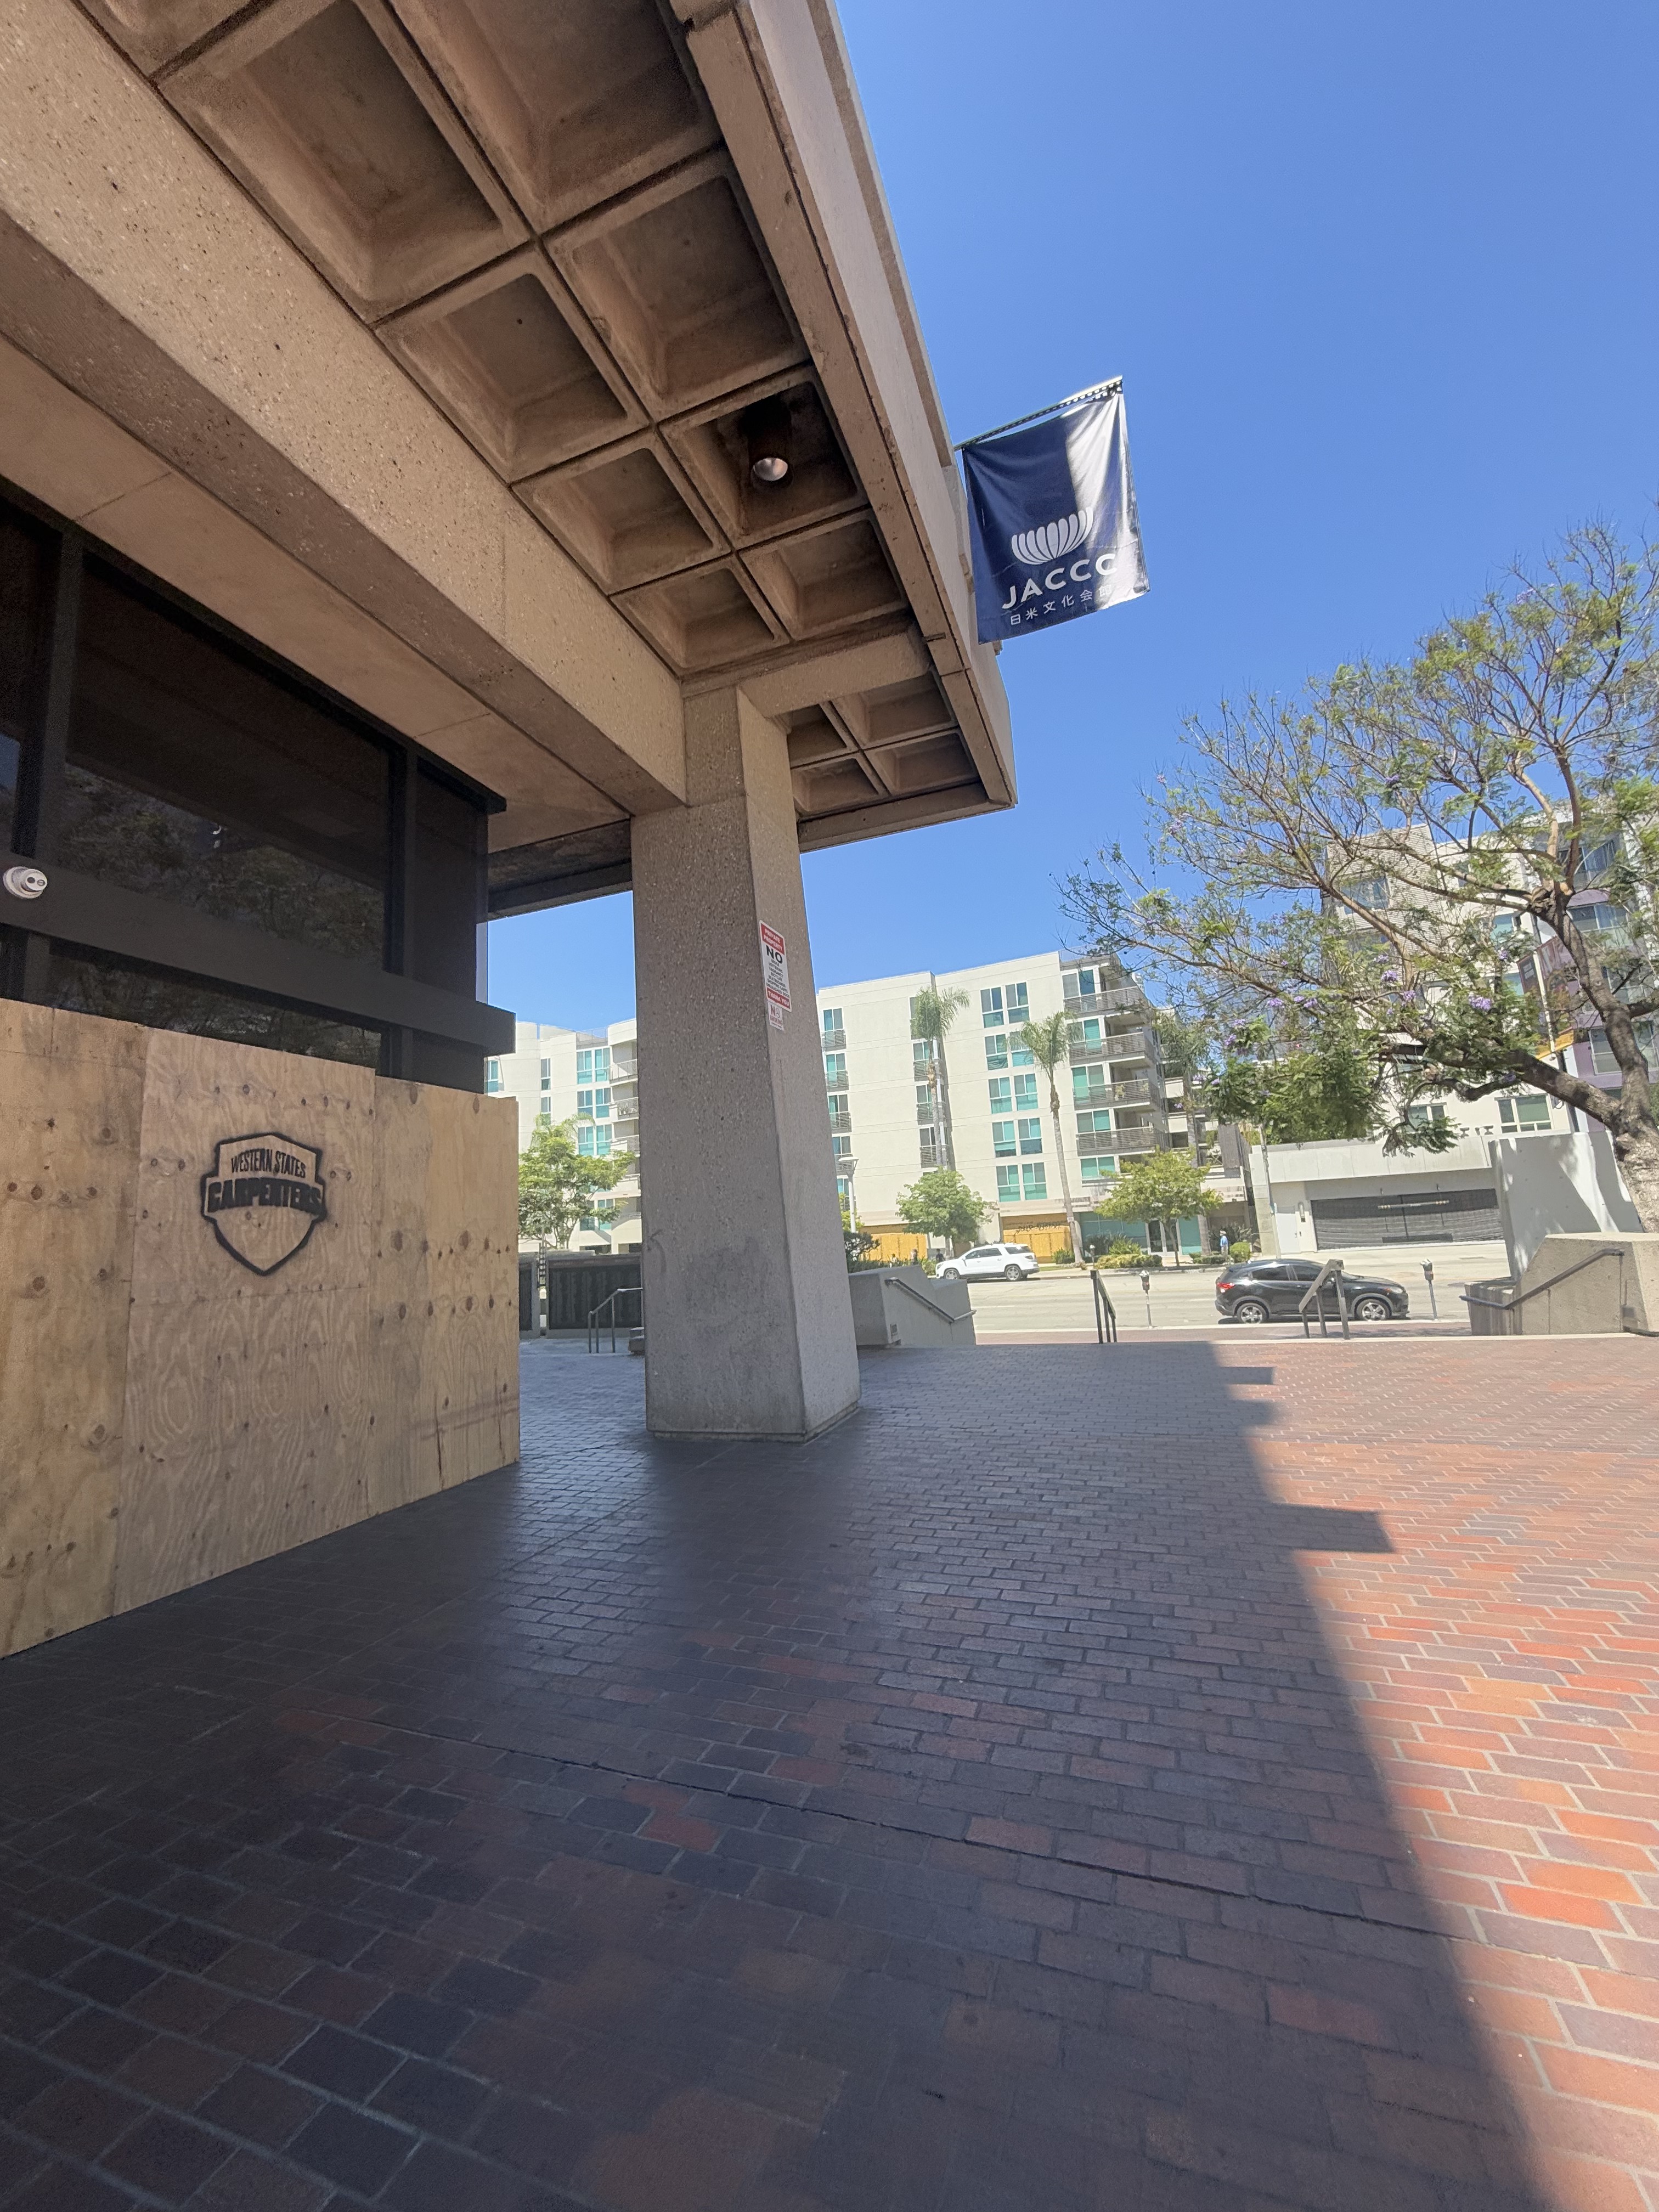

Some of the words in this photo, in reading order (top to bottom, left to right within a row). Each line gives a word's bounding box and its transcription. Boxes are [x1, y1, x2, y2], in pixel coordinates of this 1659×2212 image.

[1002, 554, 1118, 610] JACCC
[763, 934, 783, 951] PROPERTY
[764, 928, 781, 943] PRIVATE
[766, 945, 783, 964] NO
[768, 990, 781, 1002] THANK
[231, 1148, 273, 1173] WESTERN
[275, 1150, 306, 1178] STATES
[207, 1177, 323, 1215] CARPENTERS
